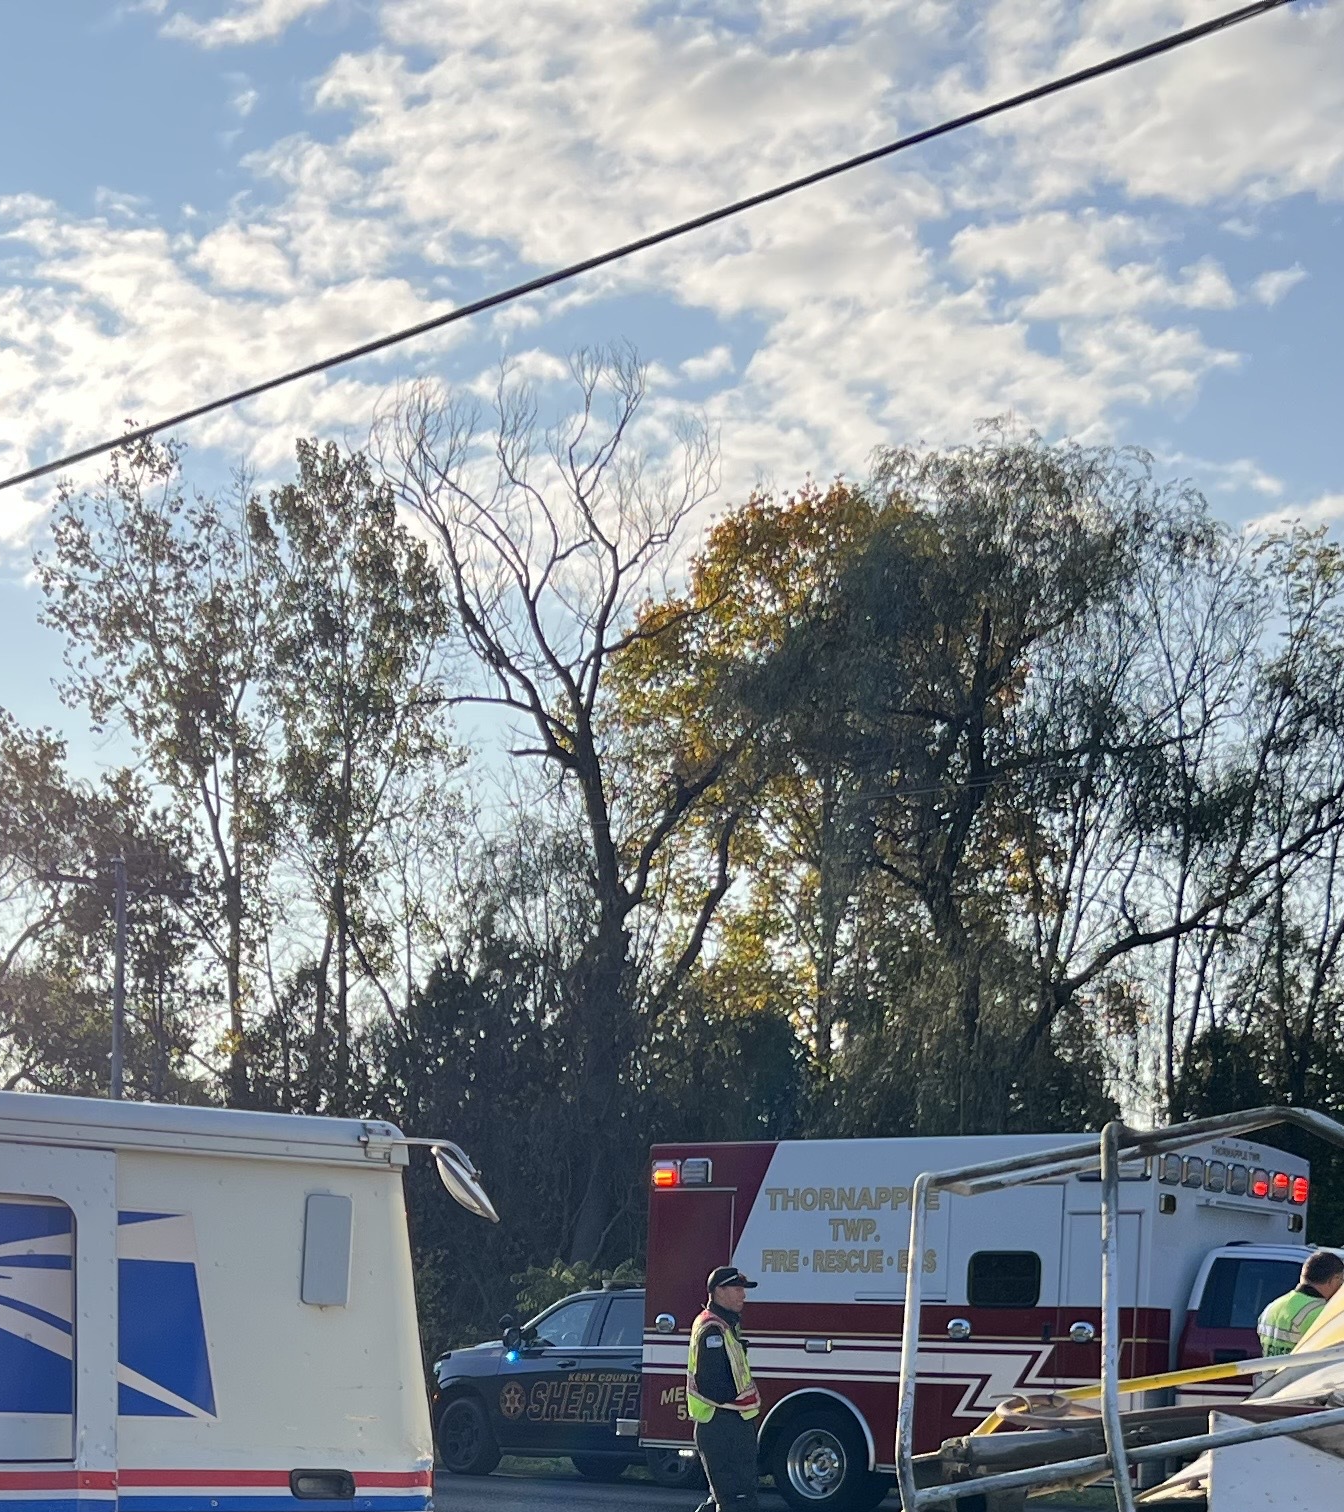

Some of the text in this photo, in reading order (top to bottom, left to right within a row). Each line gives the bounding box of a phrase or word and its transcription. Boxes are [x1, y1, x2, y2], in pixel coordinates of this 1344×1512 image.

[829, 1218, 881, 1243] TWP.
[761, 1249, 937, 1273] FIRE RESCUE ES
[568, 1372, 641, 1383] KENT COUNTY
[526, 1382, 640, 1422] SHERIFF
